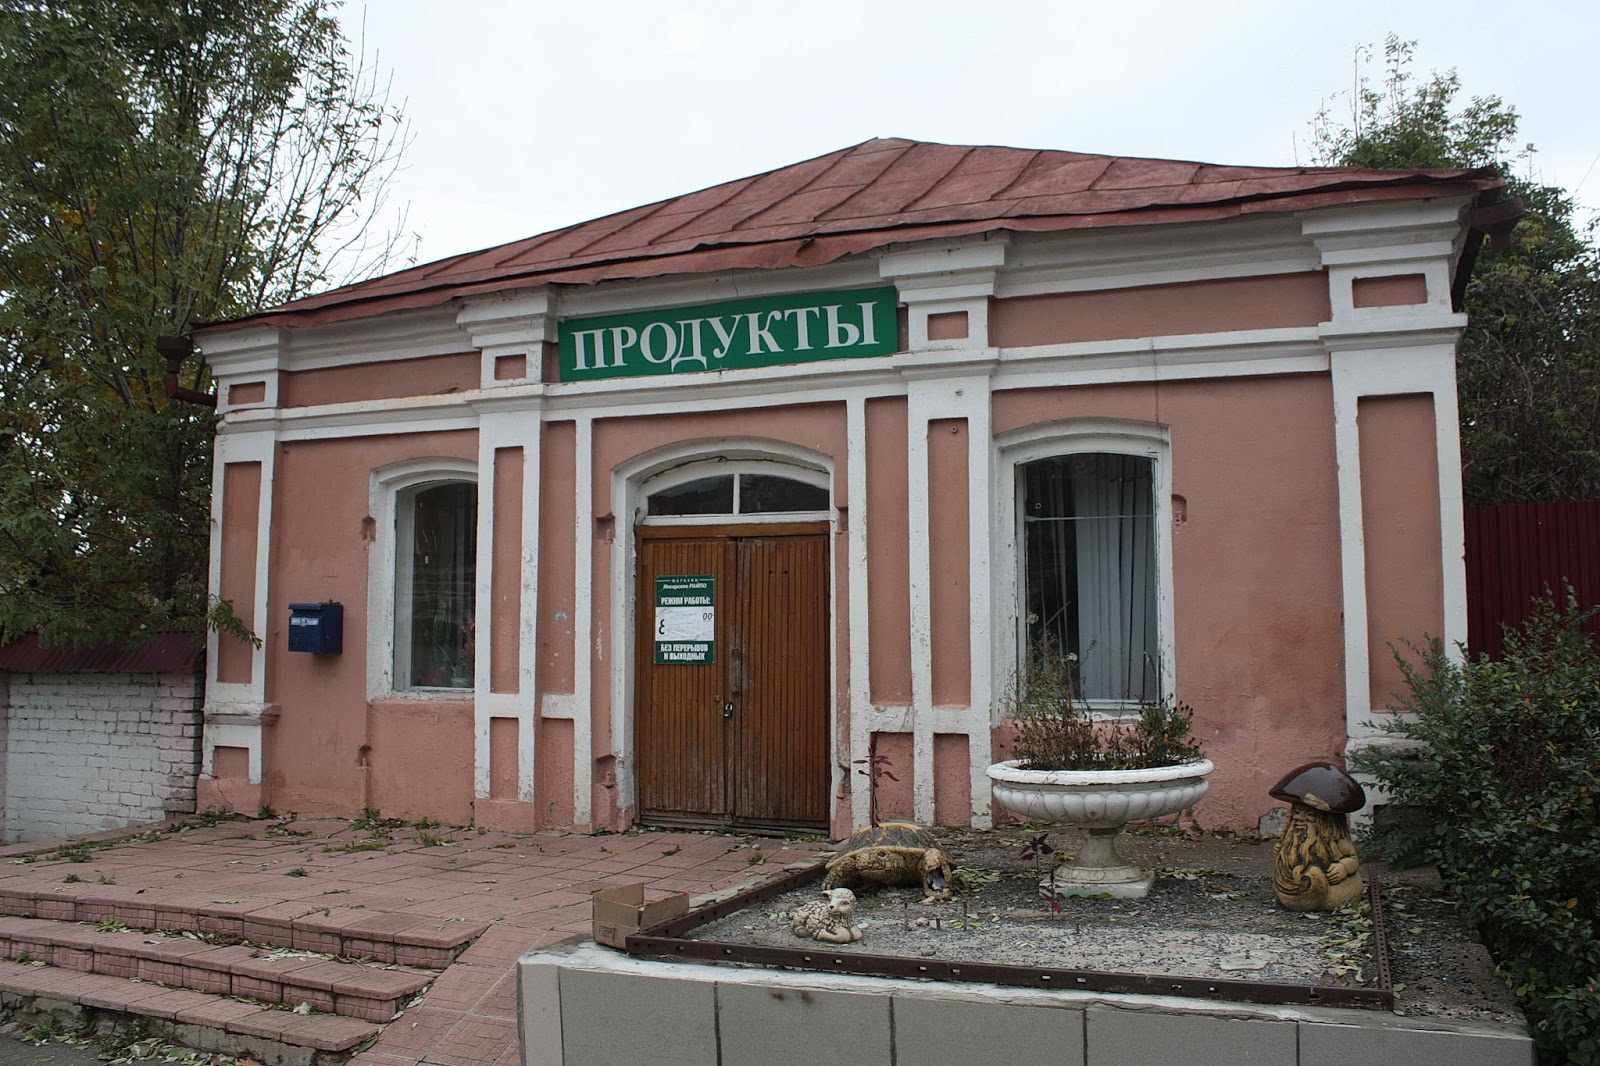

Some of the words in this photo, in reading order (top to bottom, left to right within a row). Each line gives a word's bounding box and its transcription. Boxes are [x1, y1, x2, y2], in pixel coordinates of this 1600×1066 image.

[570, 301, 880, 373] ПРОДУКТЫ
[661, 597, 683, 605] РЕЖИМ
[684, 596, 710, 604] РАБОТЫ:
[661, 644, 672, 652] БЕЗ
[673, 644, 708, 652] ПЕРЕРЫВОВ
[669, 652, 705, 661] ВЫХОДНЫХ
